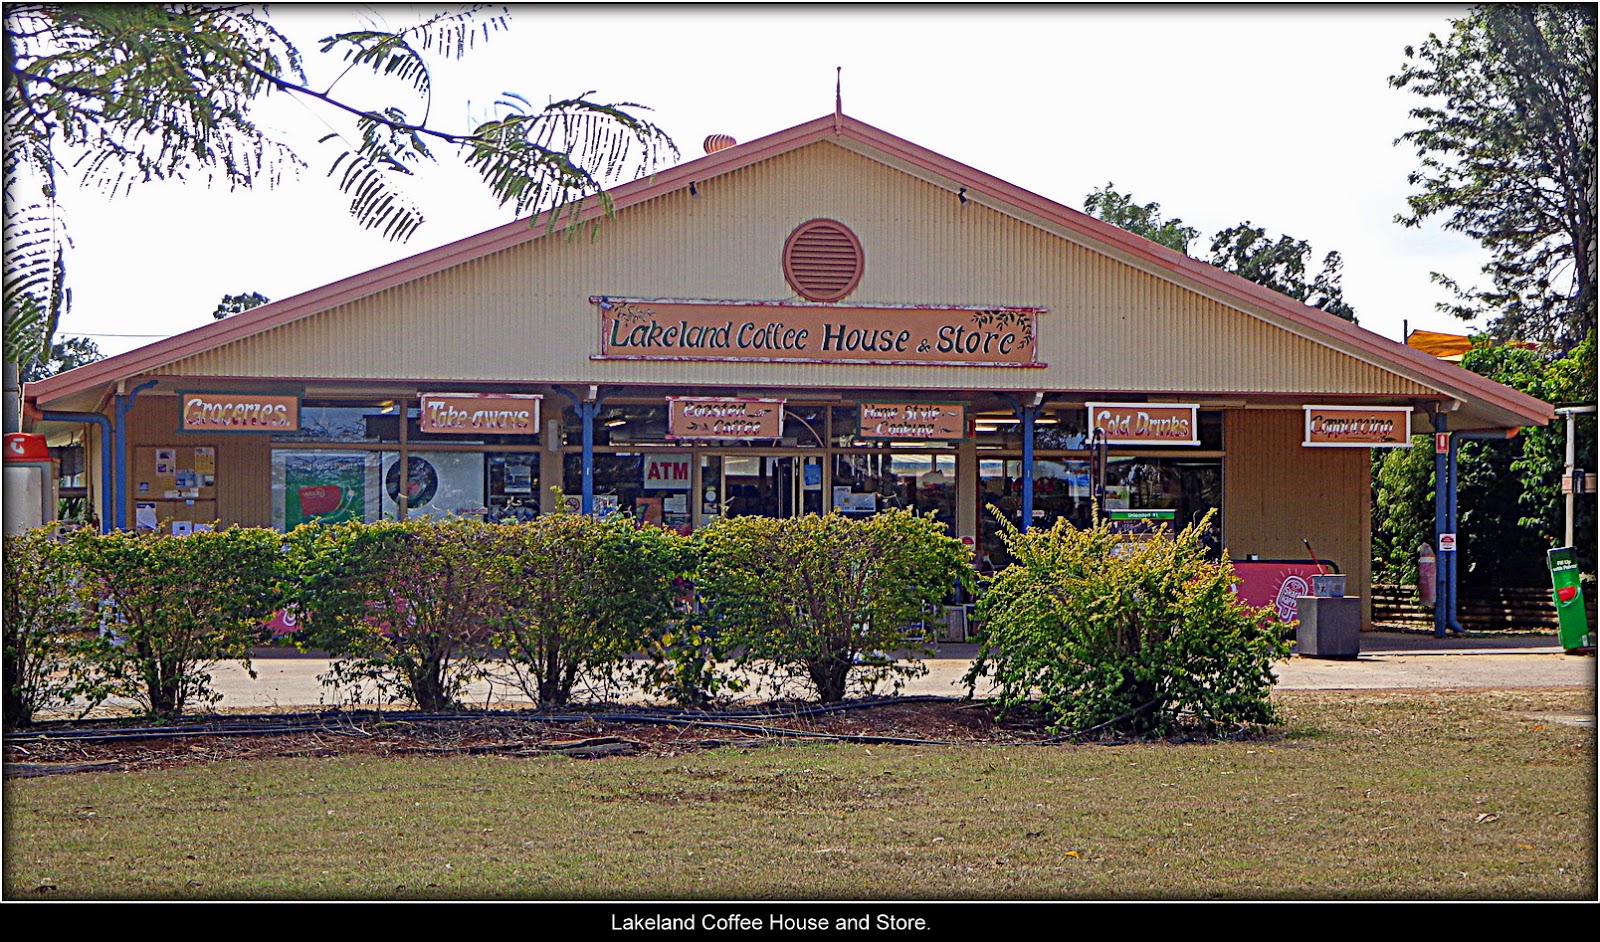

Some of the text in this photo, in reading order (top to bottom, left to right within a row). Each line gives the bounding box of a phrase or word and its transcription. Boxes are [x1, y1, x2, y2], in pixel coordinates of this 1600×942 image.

[609, 318, 1017, 355] Lakeland Coffee House & Store
[683, 402, 747, 418] Roasted
[864, 404, 899, 420] Home
[713, 420, 761, 435] Coffee
[876, 421, 935, 438] Cooking
[1095, 410, 1189, 437] Cold Drinks
[1311, 415, 1394, 438] Cappuccino
[648, 462, 689, 480] ATM
